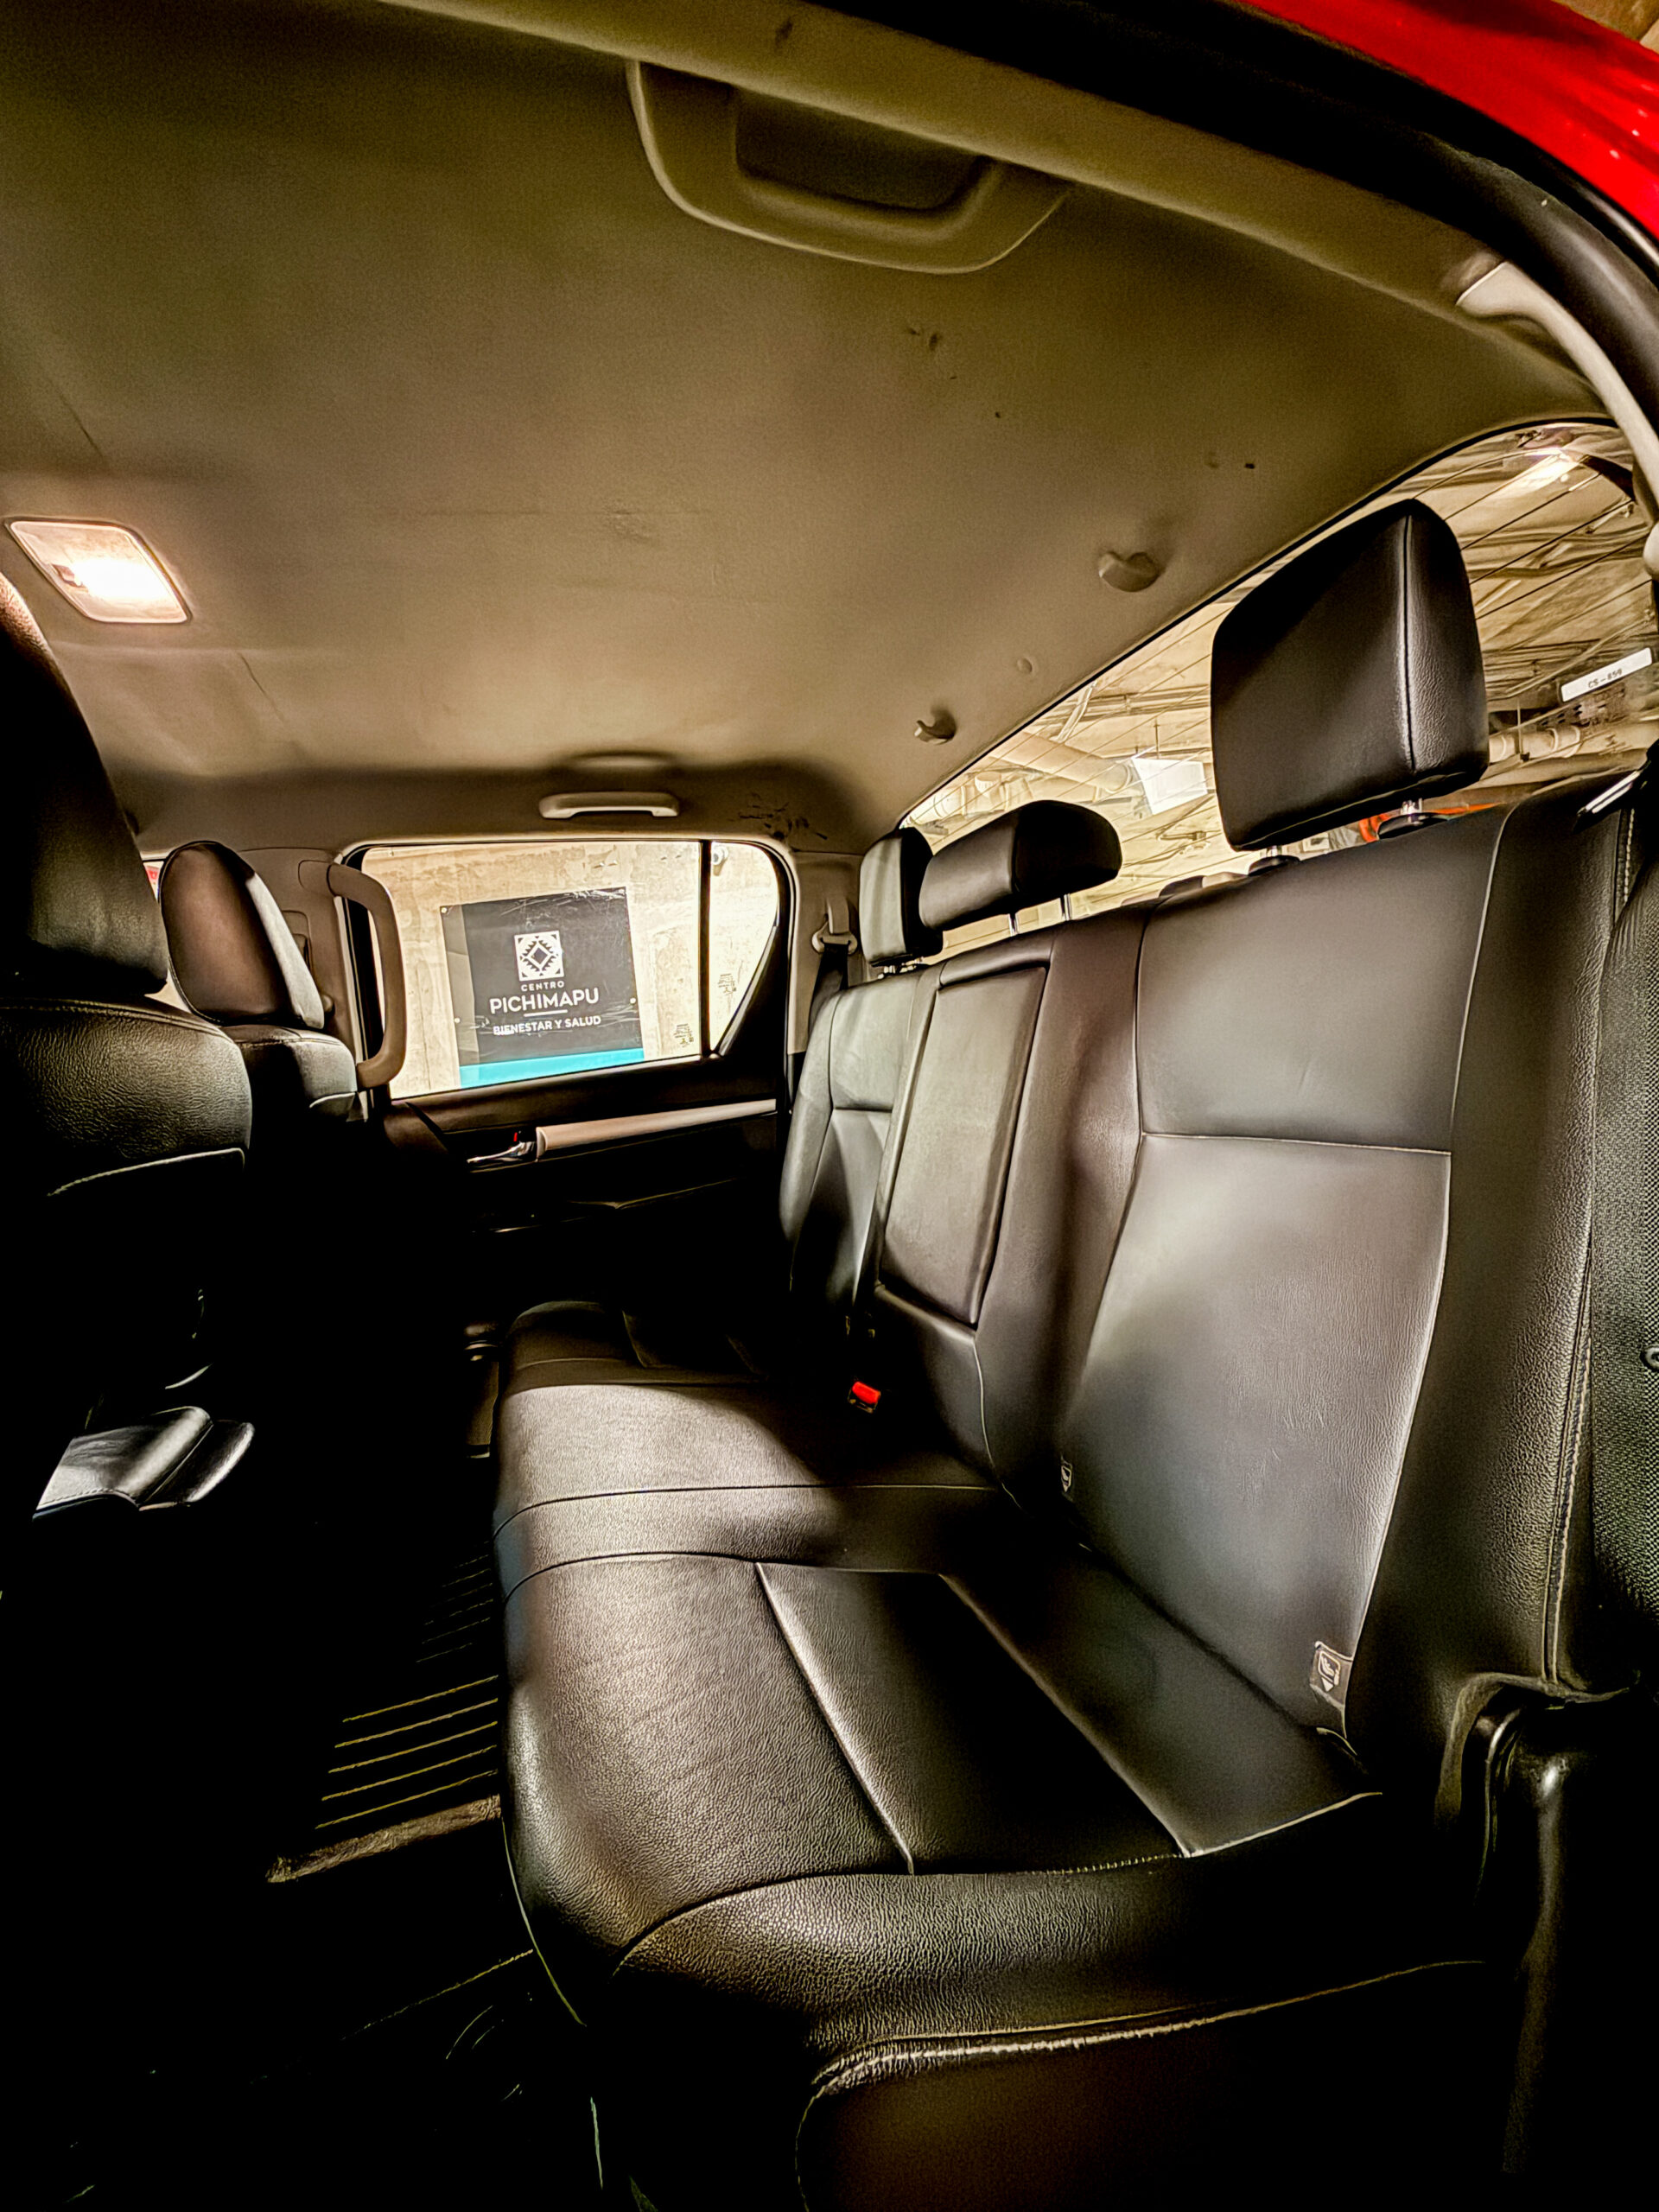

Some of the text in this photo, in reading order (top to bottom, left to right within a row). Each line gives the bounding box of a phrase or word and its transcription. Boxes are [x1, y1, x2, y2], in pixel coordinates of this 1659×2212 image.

[520, 980, 565, 992] CENTRO
[489, 988, 600, 1014] PICHIMAPU
[493, 1015, 601, 1036] BIENESTAR Y SALUD
